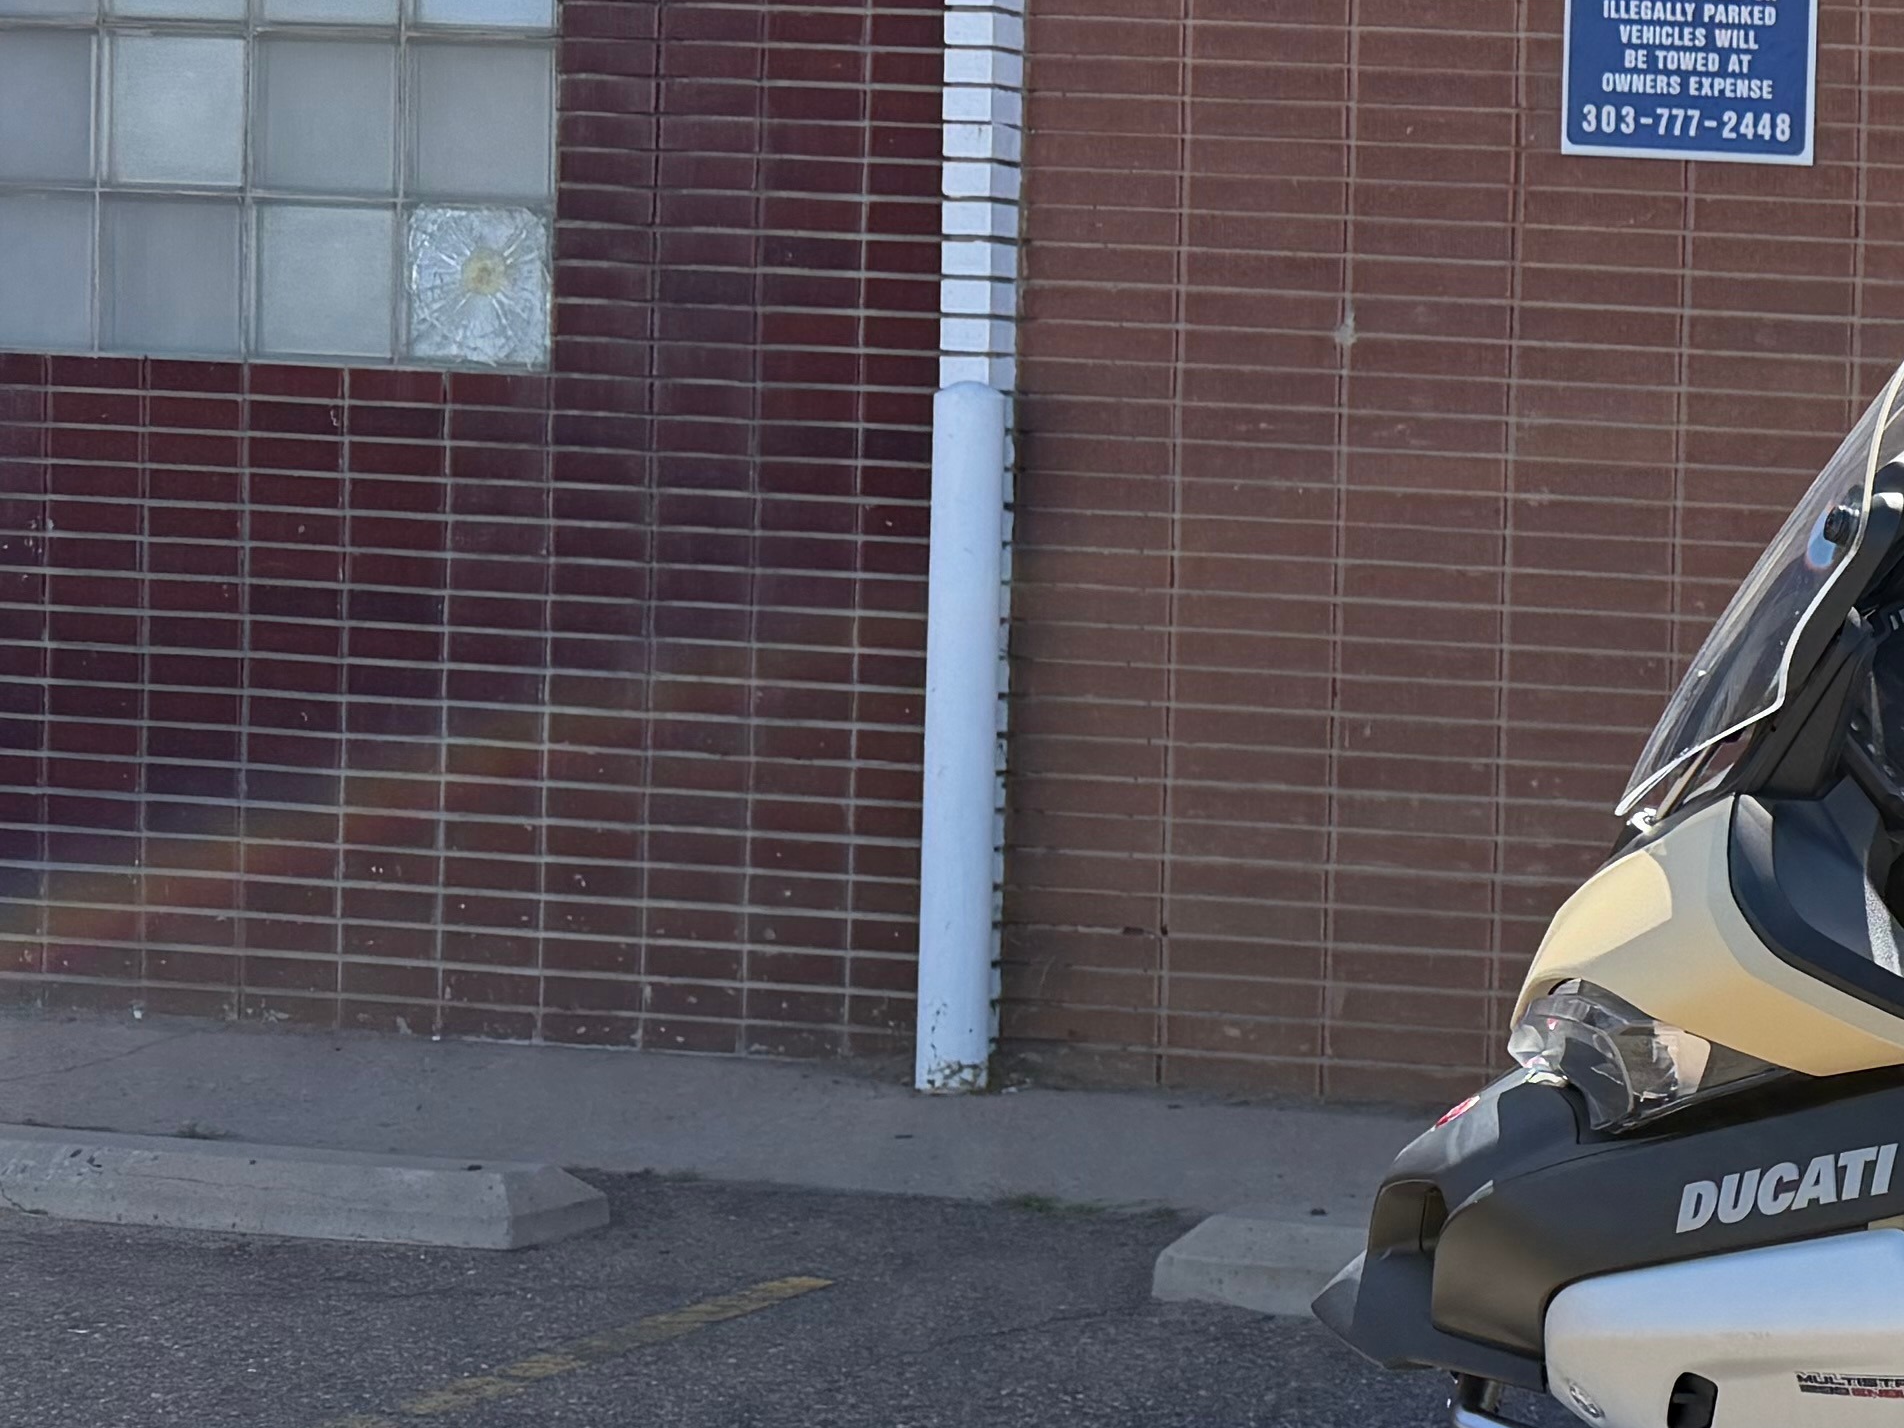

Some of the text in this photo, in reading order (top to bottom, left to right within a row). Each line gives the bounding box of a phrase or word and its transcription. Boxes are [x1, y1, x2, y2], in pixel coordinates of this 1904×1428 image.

[1603, 0, 1776, 26] ILLEGALLY PARKED
[1620, 25, 1759, 50] VEHICLES WILL
[1624, 50, 1752, 73] BE TOWED AT
[1602, 73, 1773, 99] OWNERS EXPENSE
[1582, 104, 1791, 142] 303-777-2448
[1676, 1143, 1899, 1234] DUCATI
